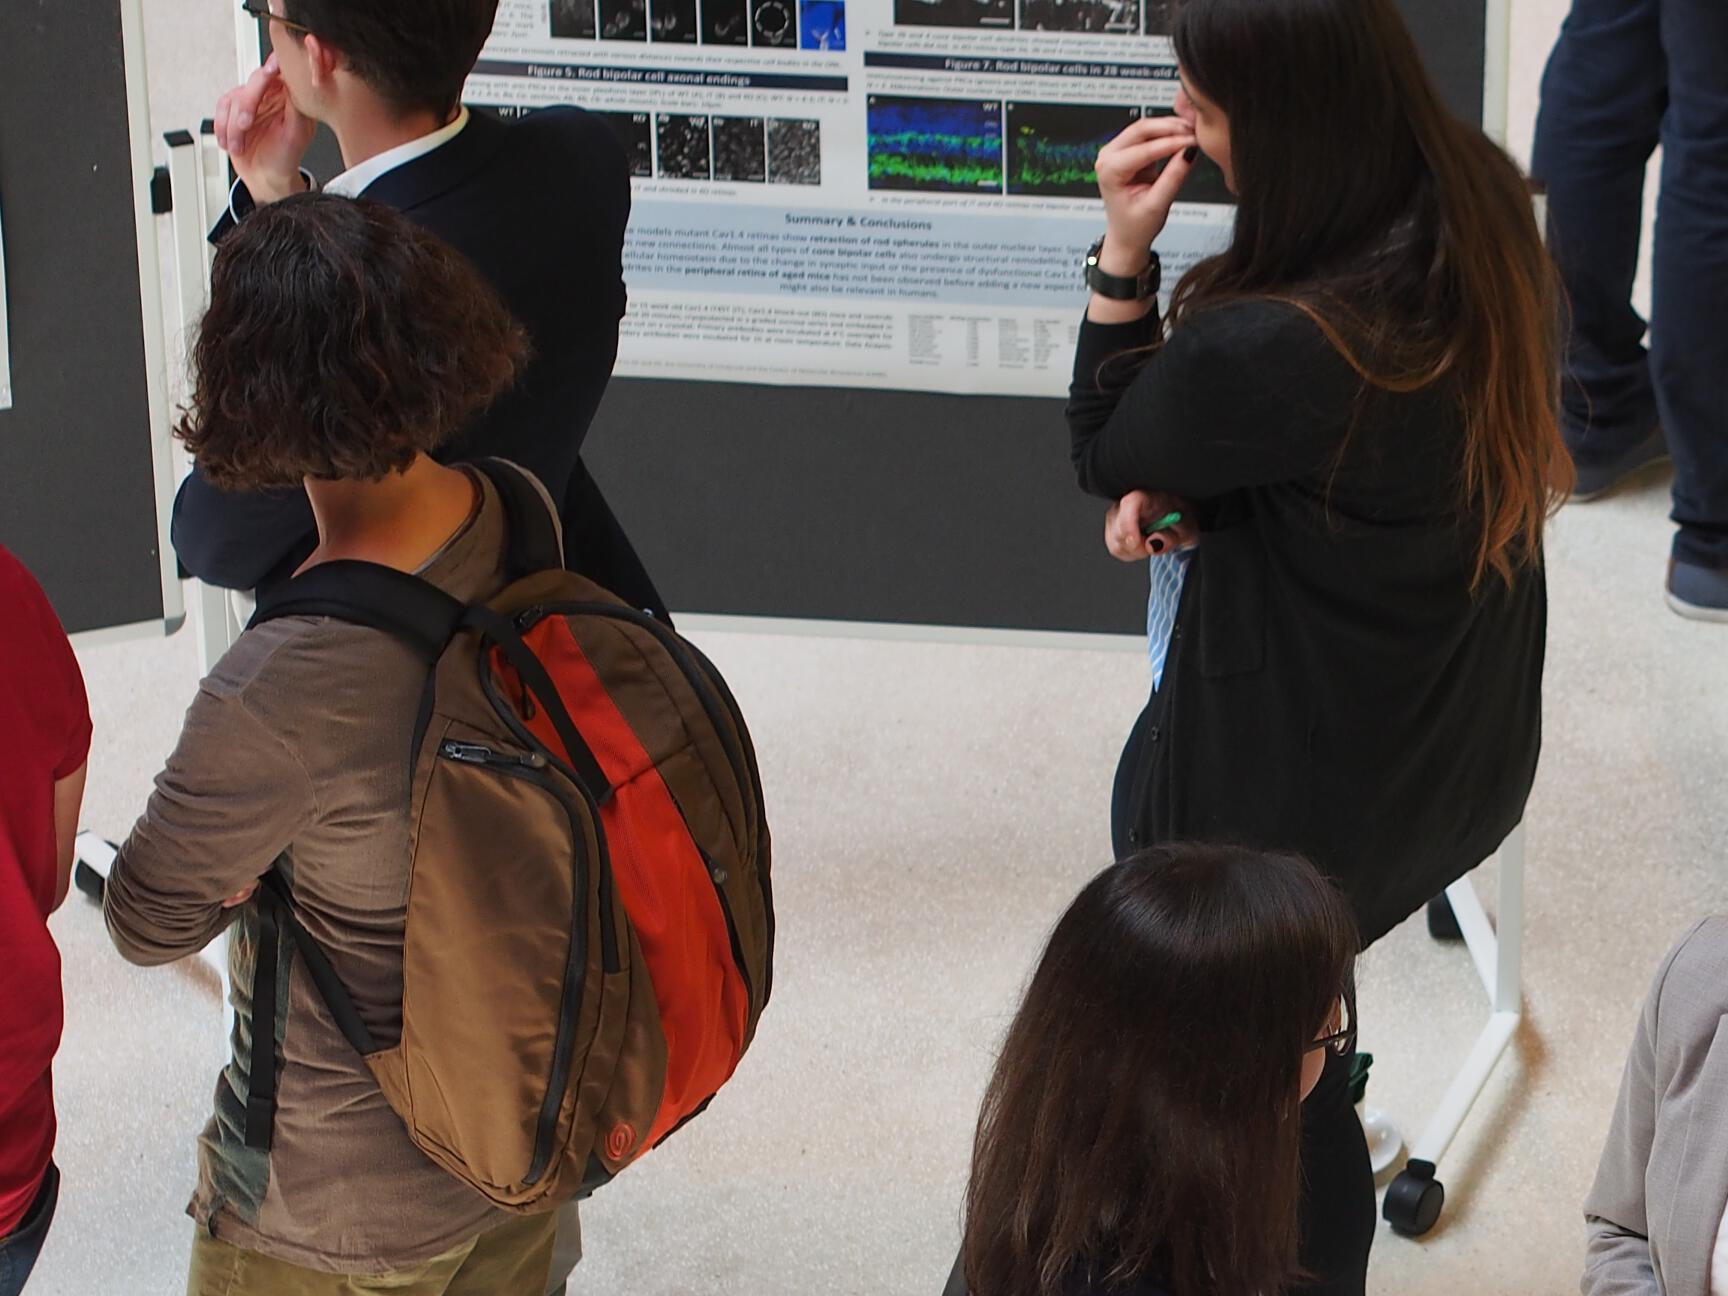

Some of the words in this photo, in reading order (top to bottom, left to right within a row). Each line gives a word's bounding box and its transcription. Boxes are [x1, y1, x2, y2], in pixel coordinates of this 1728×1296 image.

[528, 64, 561, 78] Figure
[578, 67, 599, 78] Rod
[602, 68, 641, 82] bipolar
[645, 71, 663, 82] cell
[667, 72, 703, 84] axonal
[706, 74, 749, 88] endings
[945, 58, 979, 70] Figure
[995, 60, 1016, 71] Rod
[1020, 61, 1060, 74] bipolar
[1062, 63, 1086, 74] cells
[1089, 64, 1100, 75] in
[1103, 65, 1116, 75] 28
[983, 102, 998, 112] WT
[785, 213, 843, 228] Summary
[847, 216, 856, 226] &
[860, 217, 932, 231] Conclusions
[637, 226, 671, 235] models
[674, 228, 708, 237] mutant
[746, 231, 779, 240] retinas
[783, 232, 806, 241] show
[809, 233, 857, 243] retraction
[860, 236, 870, 245] of
[873, 237, 889, 245] rod
[892, 238, 938, 250] spherules
[942, 240, 949, 248] in
[953, 240, 968, 249] the
[972, 241, 995, 250] outer
[1000, 242, 1035, 252] nuclear
[721, 242, 753, 252] Almost
[757, 244, 768, 252] all
[771, 244, 793, 256] types
[797, 245, 808, 254] of
[838, 247, 871, 259] bipolar
[874, 249, 895, 258] cells
[898, 250, 917, 259] also
[920, 251, 960, 263] undergo
[963, 253, 1007, 263] structural
[719, 254, 736, 263] due
[740, 255, 748, 263] to
[752, 256, 767, 264] the
[770, 256, 803, 268] change
[807, 258, 816, 266] in
[819, 258, 857, 270] synaptic
[861, 262, 884, 273] input
[901, 263, 917, 272] the
[920, 266, 962, 276] presence
[966, 266, 975, 274] of
[978, 266, 1041, 279] dysfunctional
[655, 264, 662, 272] in
[666, 265, 681, 273] the
[684, 266, 734, 278] peripheral
[737, 268, 765, 277] retina
[768, 269, 778, 277] of
[781, 270, 804, 280] aged
[807, 271, 829, 279] mice
[832, 272, 848, 280] has
[851, 273, 868, 281] not
[871, 274, 894, 283] been
[897, 275, 940, 285] observed
[943, 277, 973, 287] before
[977, 279, 1008, 290] adding
[1043, 282, 1072, 293] aspect
[780, 283, 806, 294] might
[810, 284, 828, 293] also
[831, 284, 844, 293] be
[846, 286, 884, 296] relevant
[887, 288, 896, 296] in
